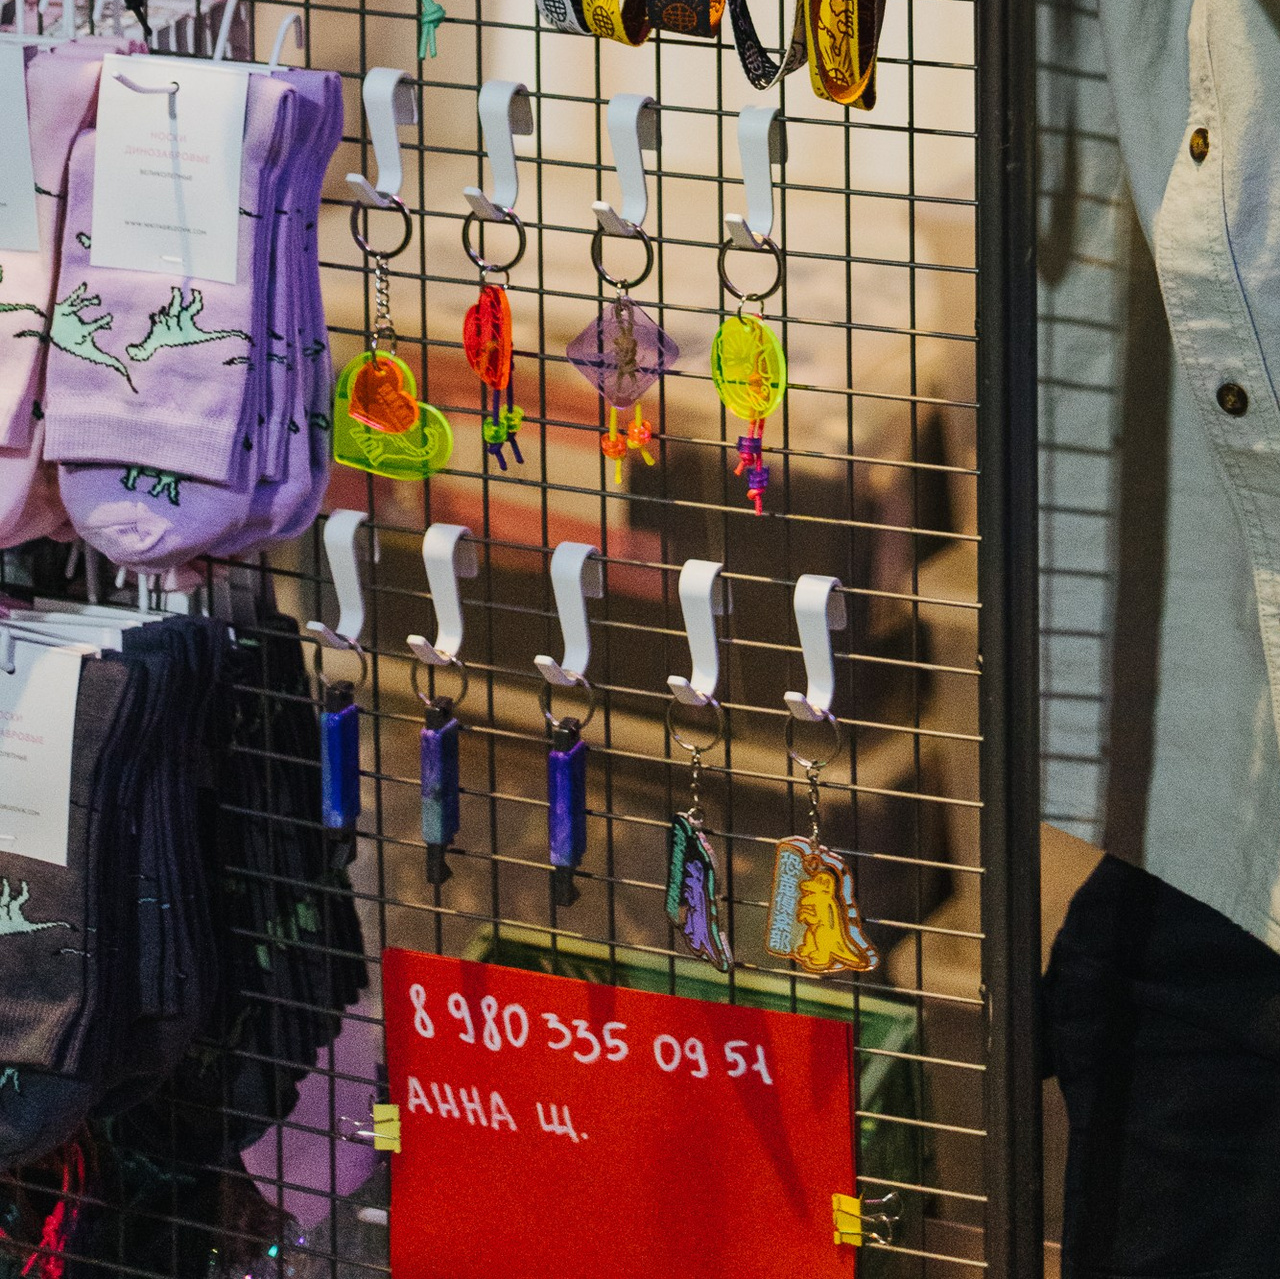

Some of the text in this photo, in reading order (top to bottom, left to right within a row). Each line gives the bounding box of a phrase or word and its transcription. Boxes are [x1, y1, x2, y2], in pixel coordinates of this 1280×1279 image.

[150, 132, 186, 143] НОСКИ
[409, 983, 435, 1038] 8
[447, 992, 530, 1052] 980
[541, 1012, 629, 1064] 335
[653, 1033, 709, 1079] 09
[407, 1075, 589, 1143] АННА Щ.
